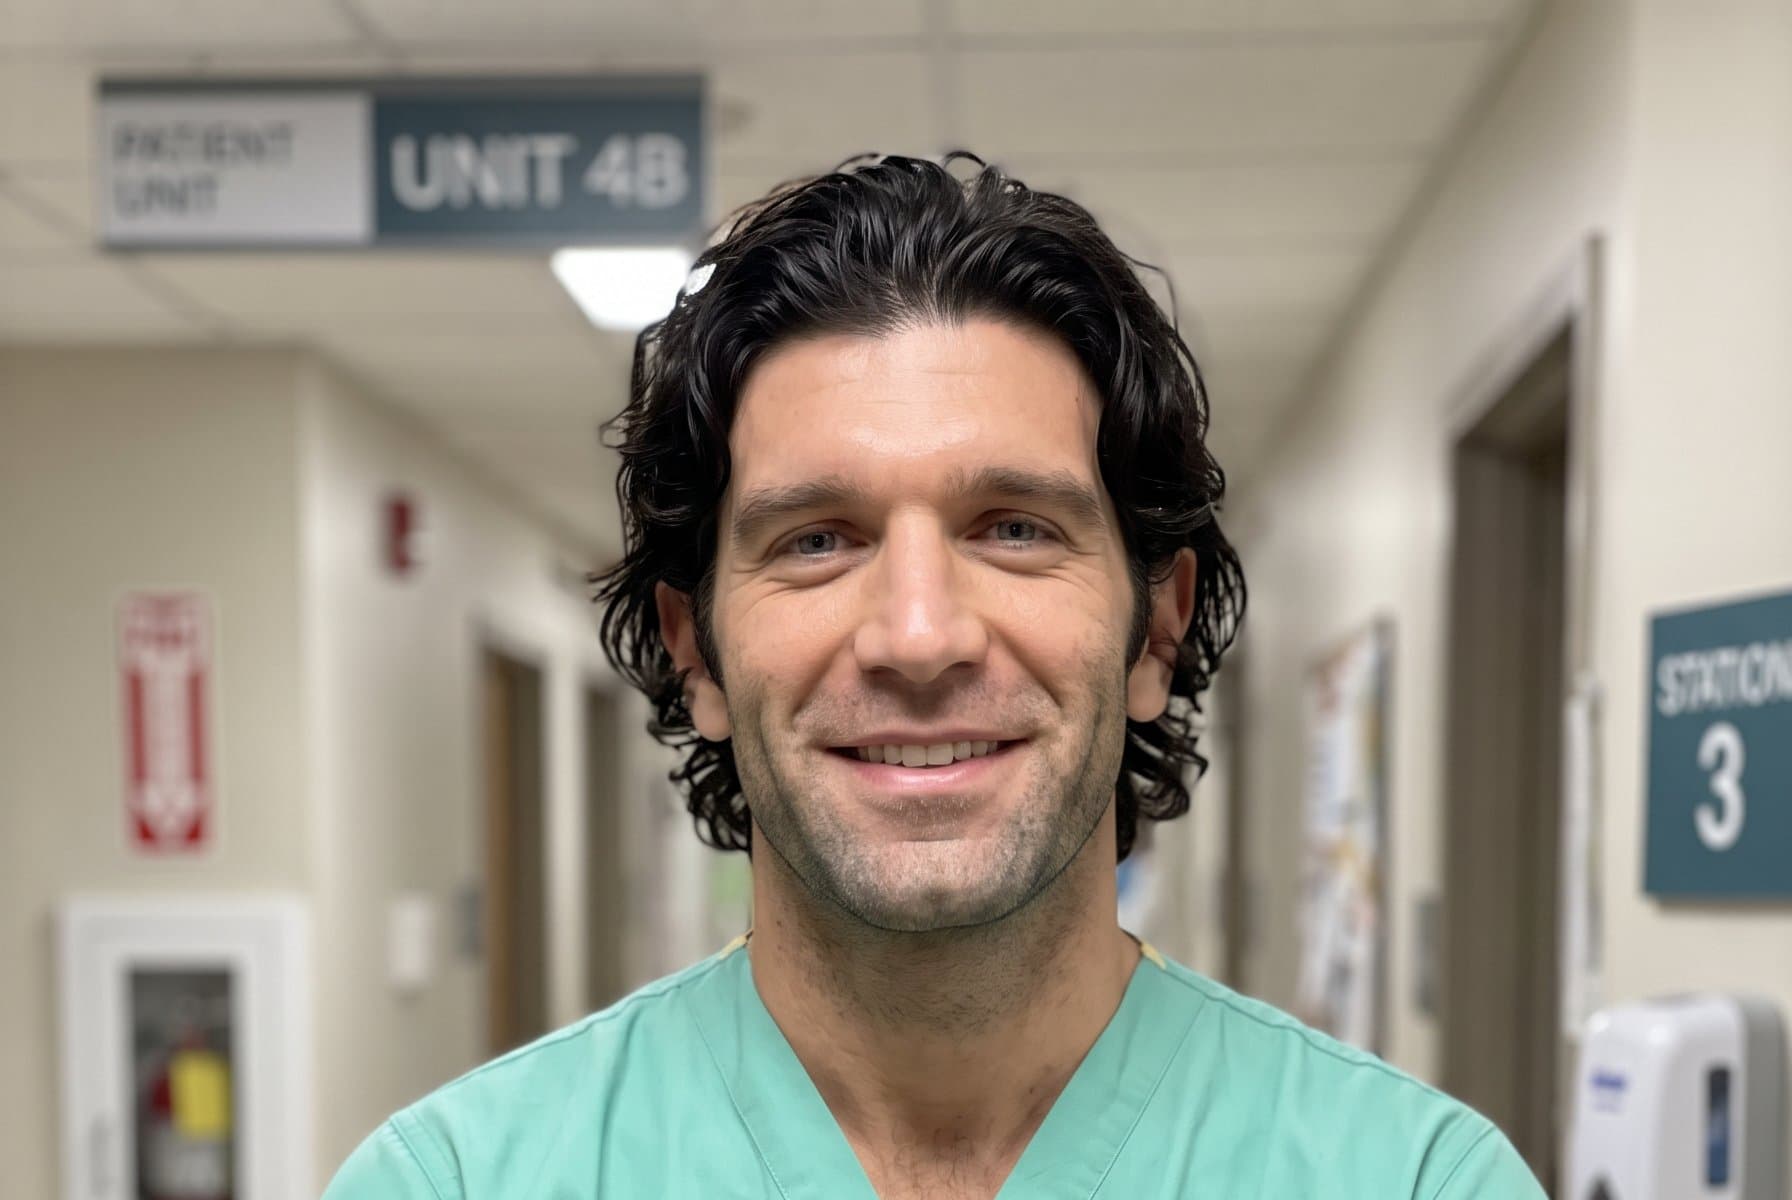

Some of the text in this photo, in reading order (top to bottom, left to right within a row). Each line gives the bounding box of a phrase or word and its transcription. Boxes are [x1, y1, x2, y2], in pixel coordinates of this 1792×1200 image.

[113, 121, 293, 163] PATIENT
[391, 133, 687, 210] UNIT 4B
[1695, 721, 1745, 850] 3
